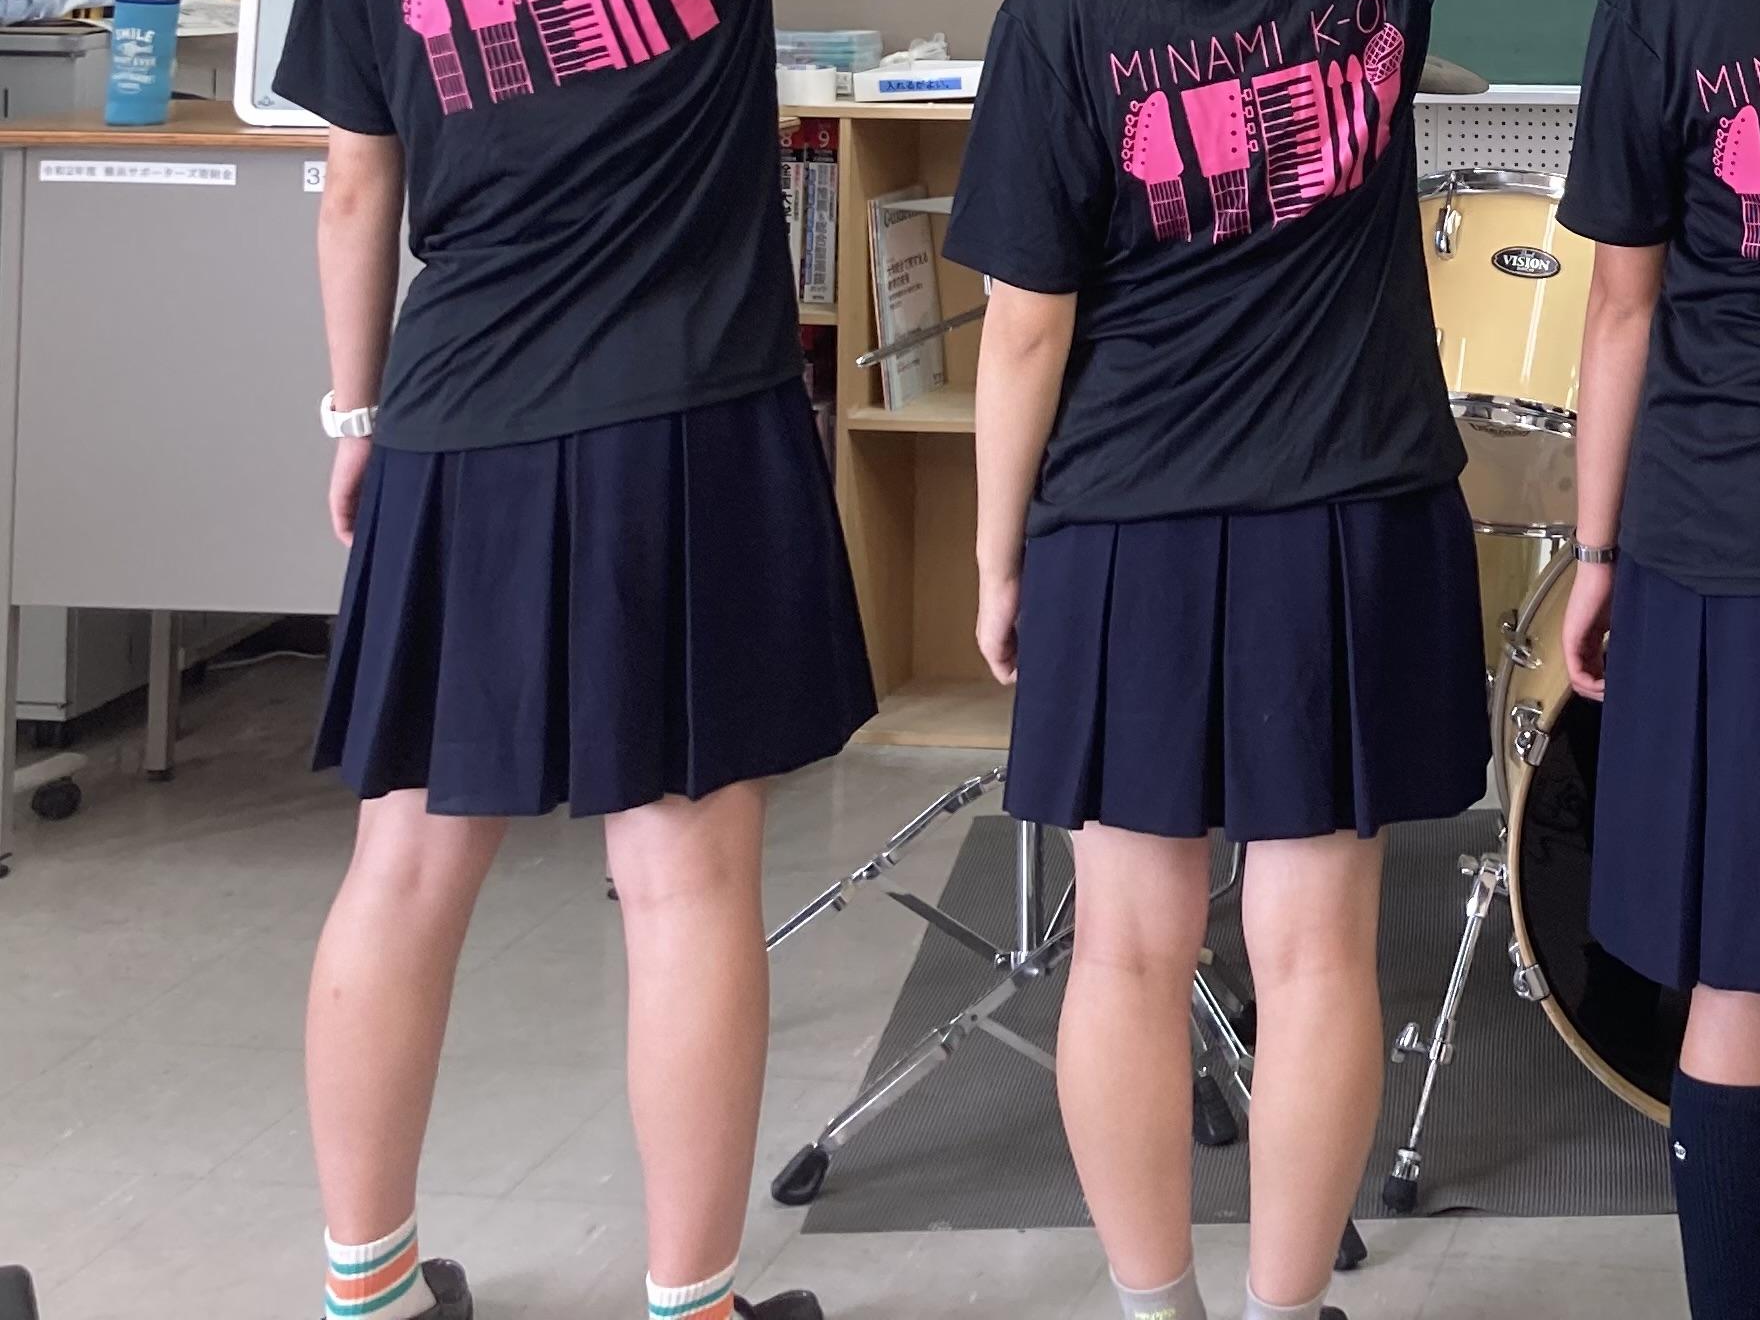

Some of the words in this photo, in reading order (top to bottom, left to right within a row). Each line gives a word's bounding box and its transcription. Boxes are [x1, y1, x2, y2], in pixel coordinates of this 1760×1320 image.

[1110, 21, 1282, 95] MINAMI
[819, 130, 830, 148] 9
[1503, 254, 1550, 271] VISION
